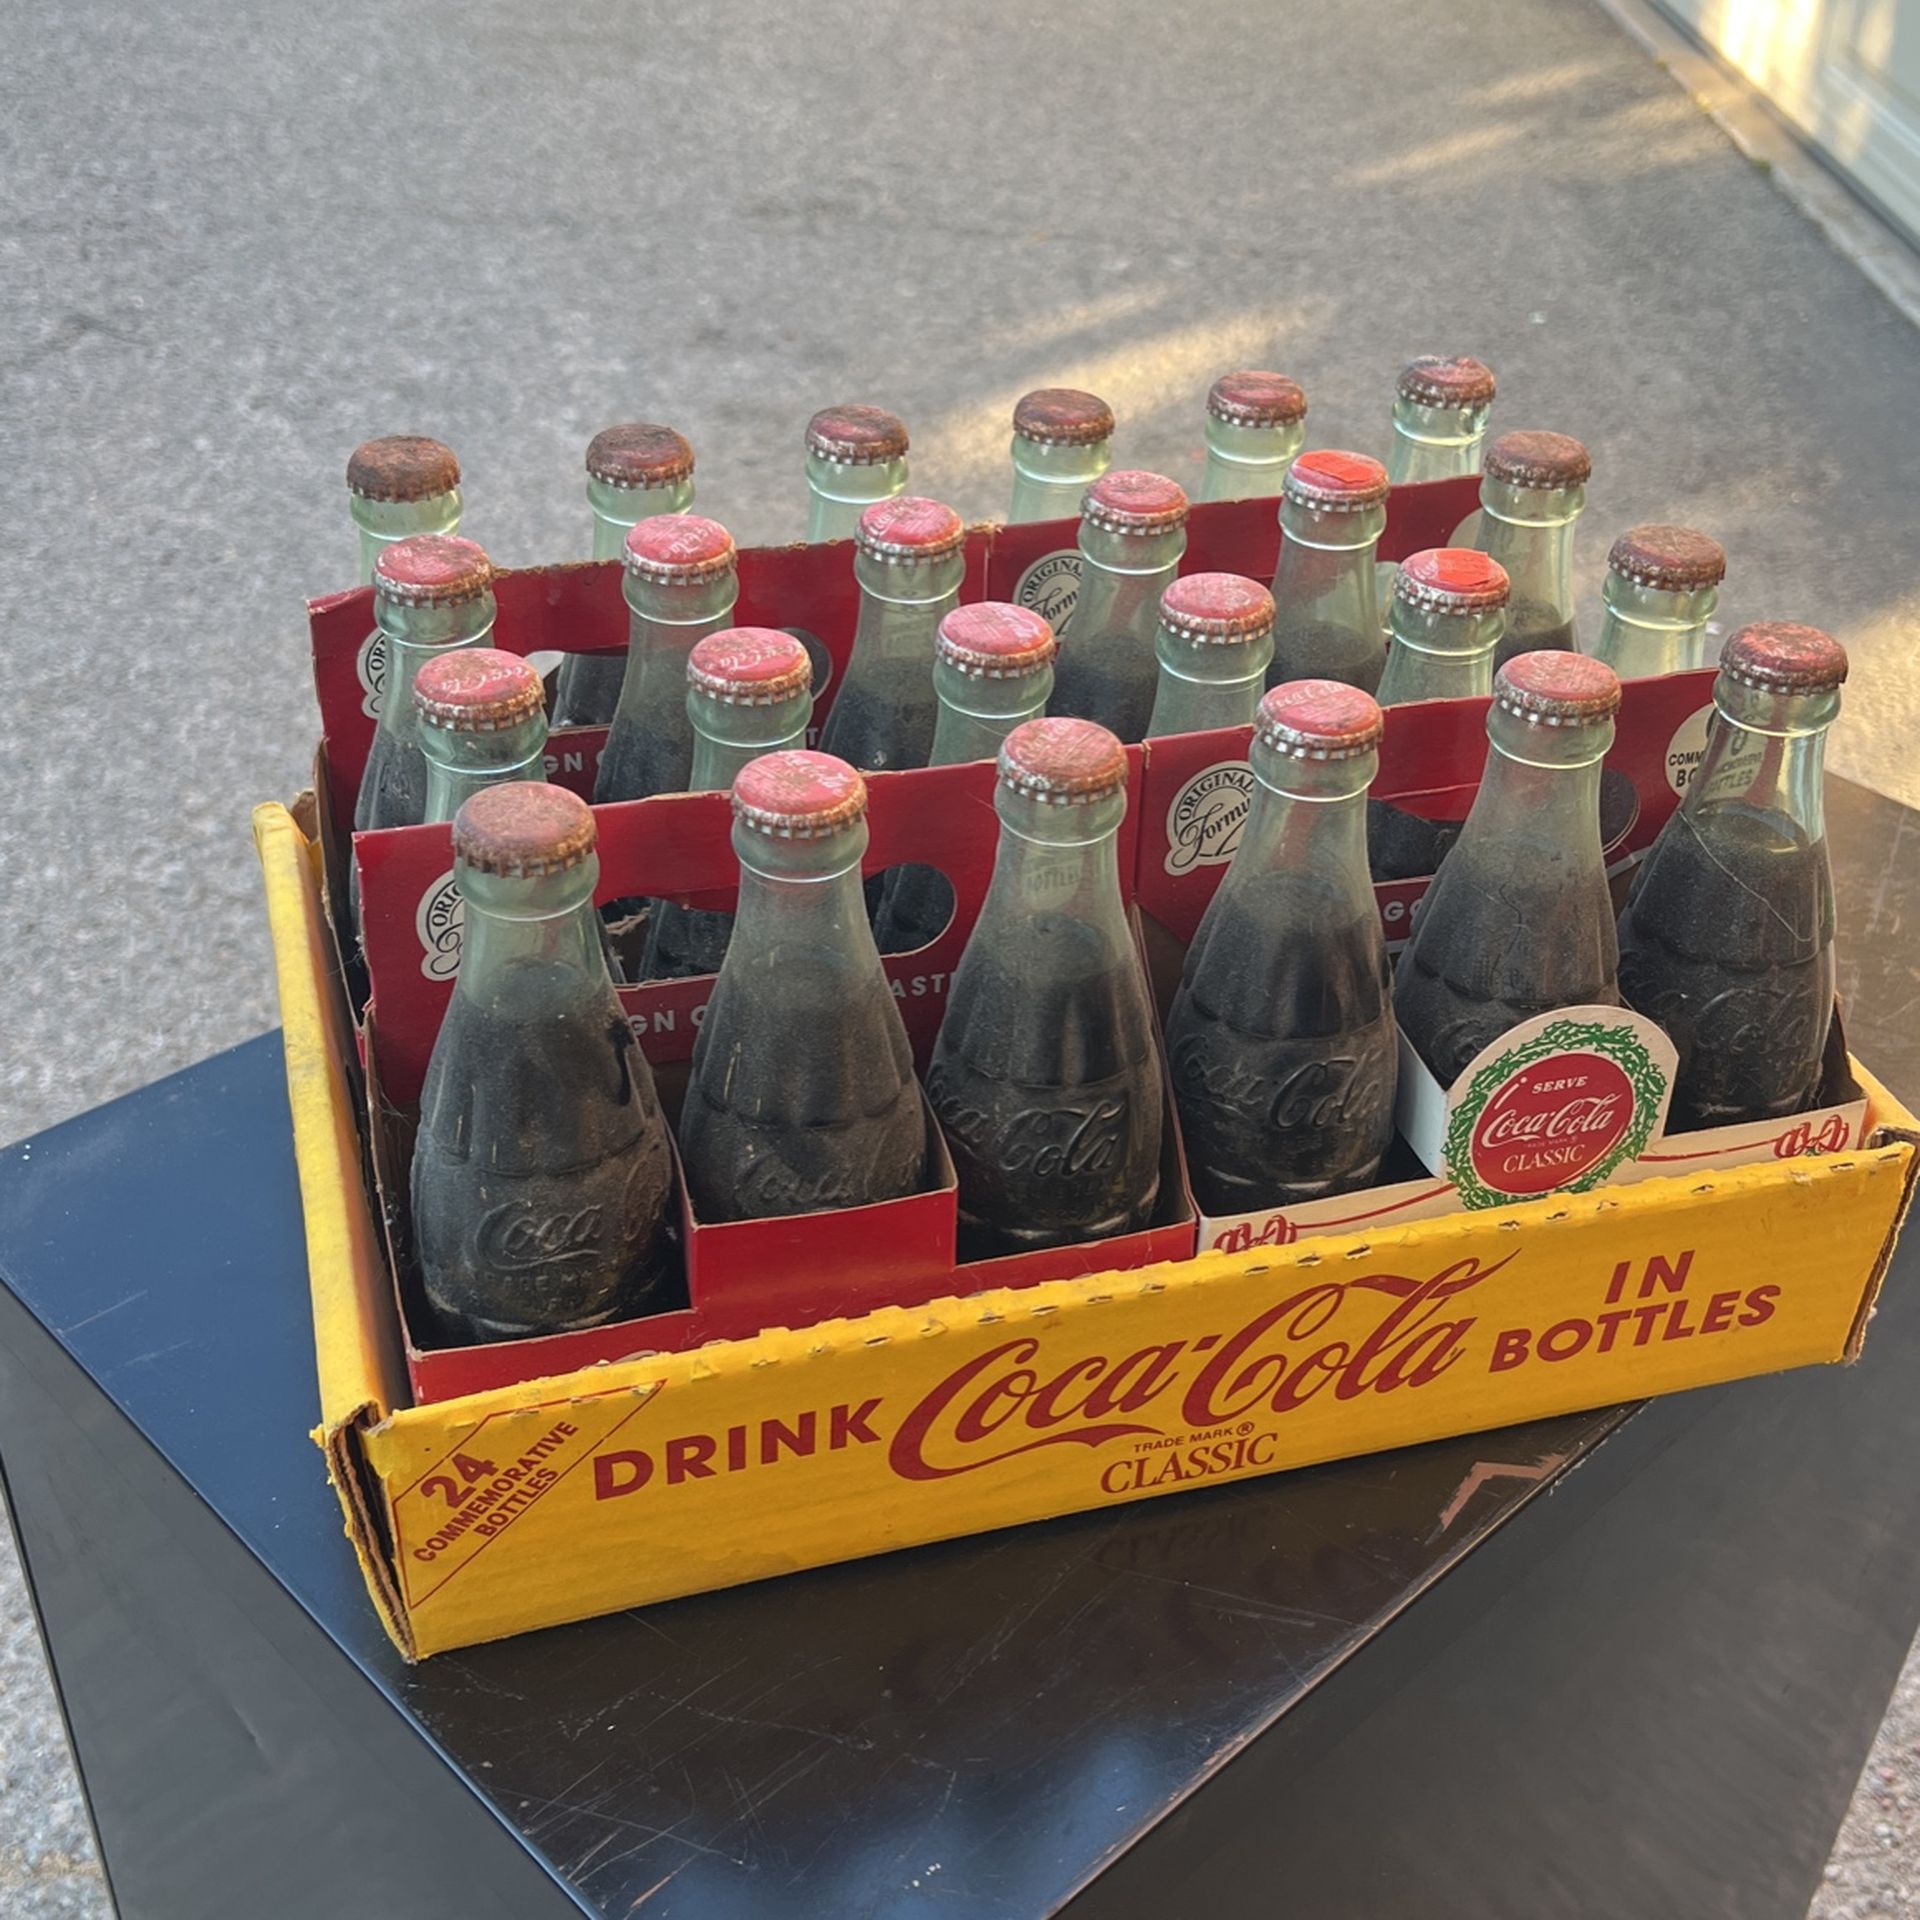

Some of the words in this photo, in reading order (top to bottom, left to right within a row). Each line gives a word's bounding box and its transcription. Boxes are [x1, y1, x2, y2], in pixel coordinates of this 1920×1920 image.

[1022, 558, 1082, 603] ORIGINA
[1179, 771, 1255, 821] ORIGINAL
[1532, 1075, 1589, 1095] SERVE
[1481, 1094, 1622, 1148] Coca-Cola
[1503, 1143, 1586, 1174] CLASSIC
[1604, 1250, 1695, 1304] IN
[1488, 1284, 1782, 1374] BOTTLES
[593, 1397, 884, 1501] DRINK
[888, 1247, 1522, 1481] Coca-Cola
[1101, 1432, 1279, 1494] CLASSIC
[1134, 1435, 1185, 1454] TRADE
[413, 1421, 580, 1562] COMMEMORATIVE
[420, 1452, 500, 1509] 24
[473, 1467, 559, 1537] BOTTLES
